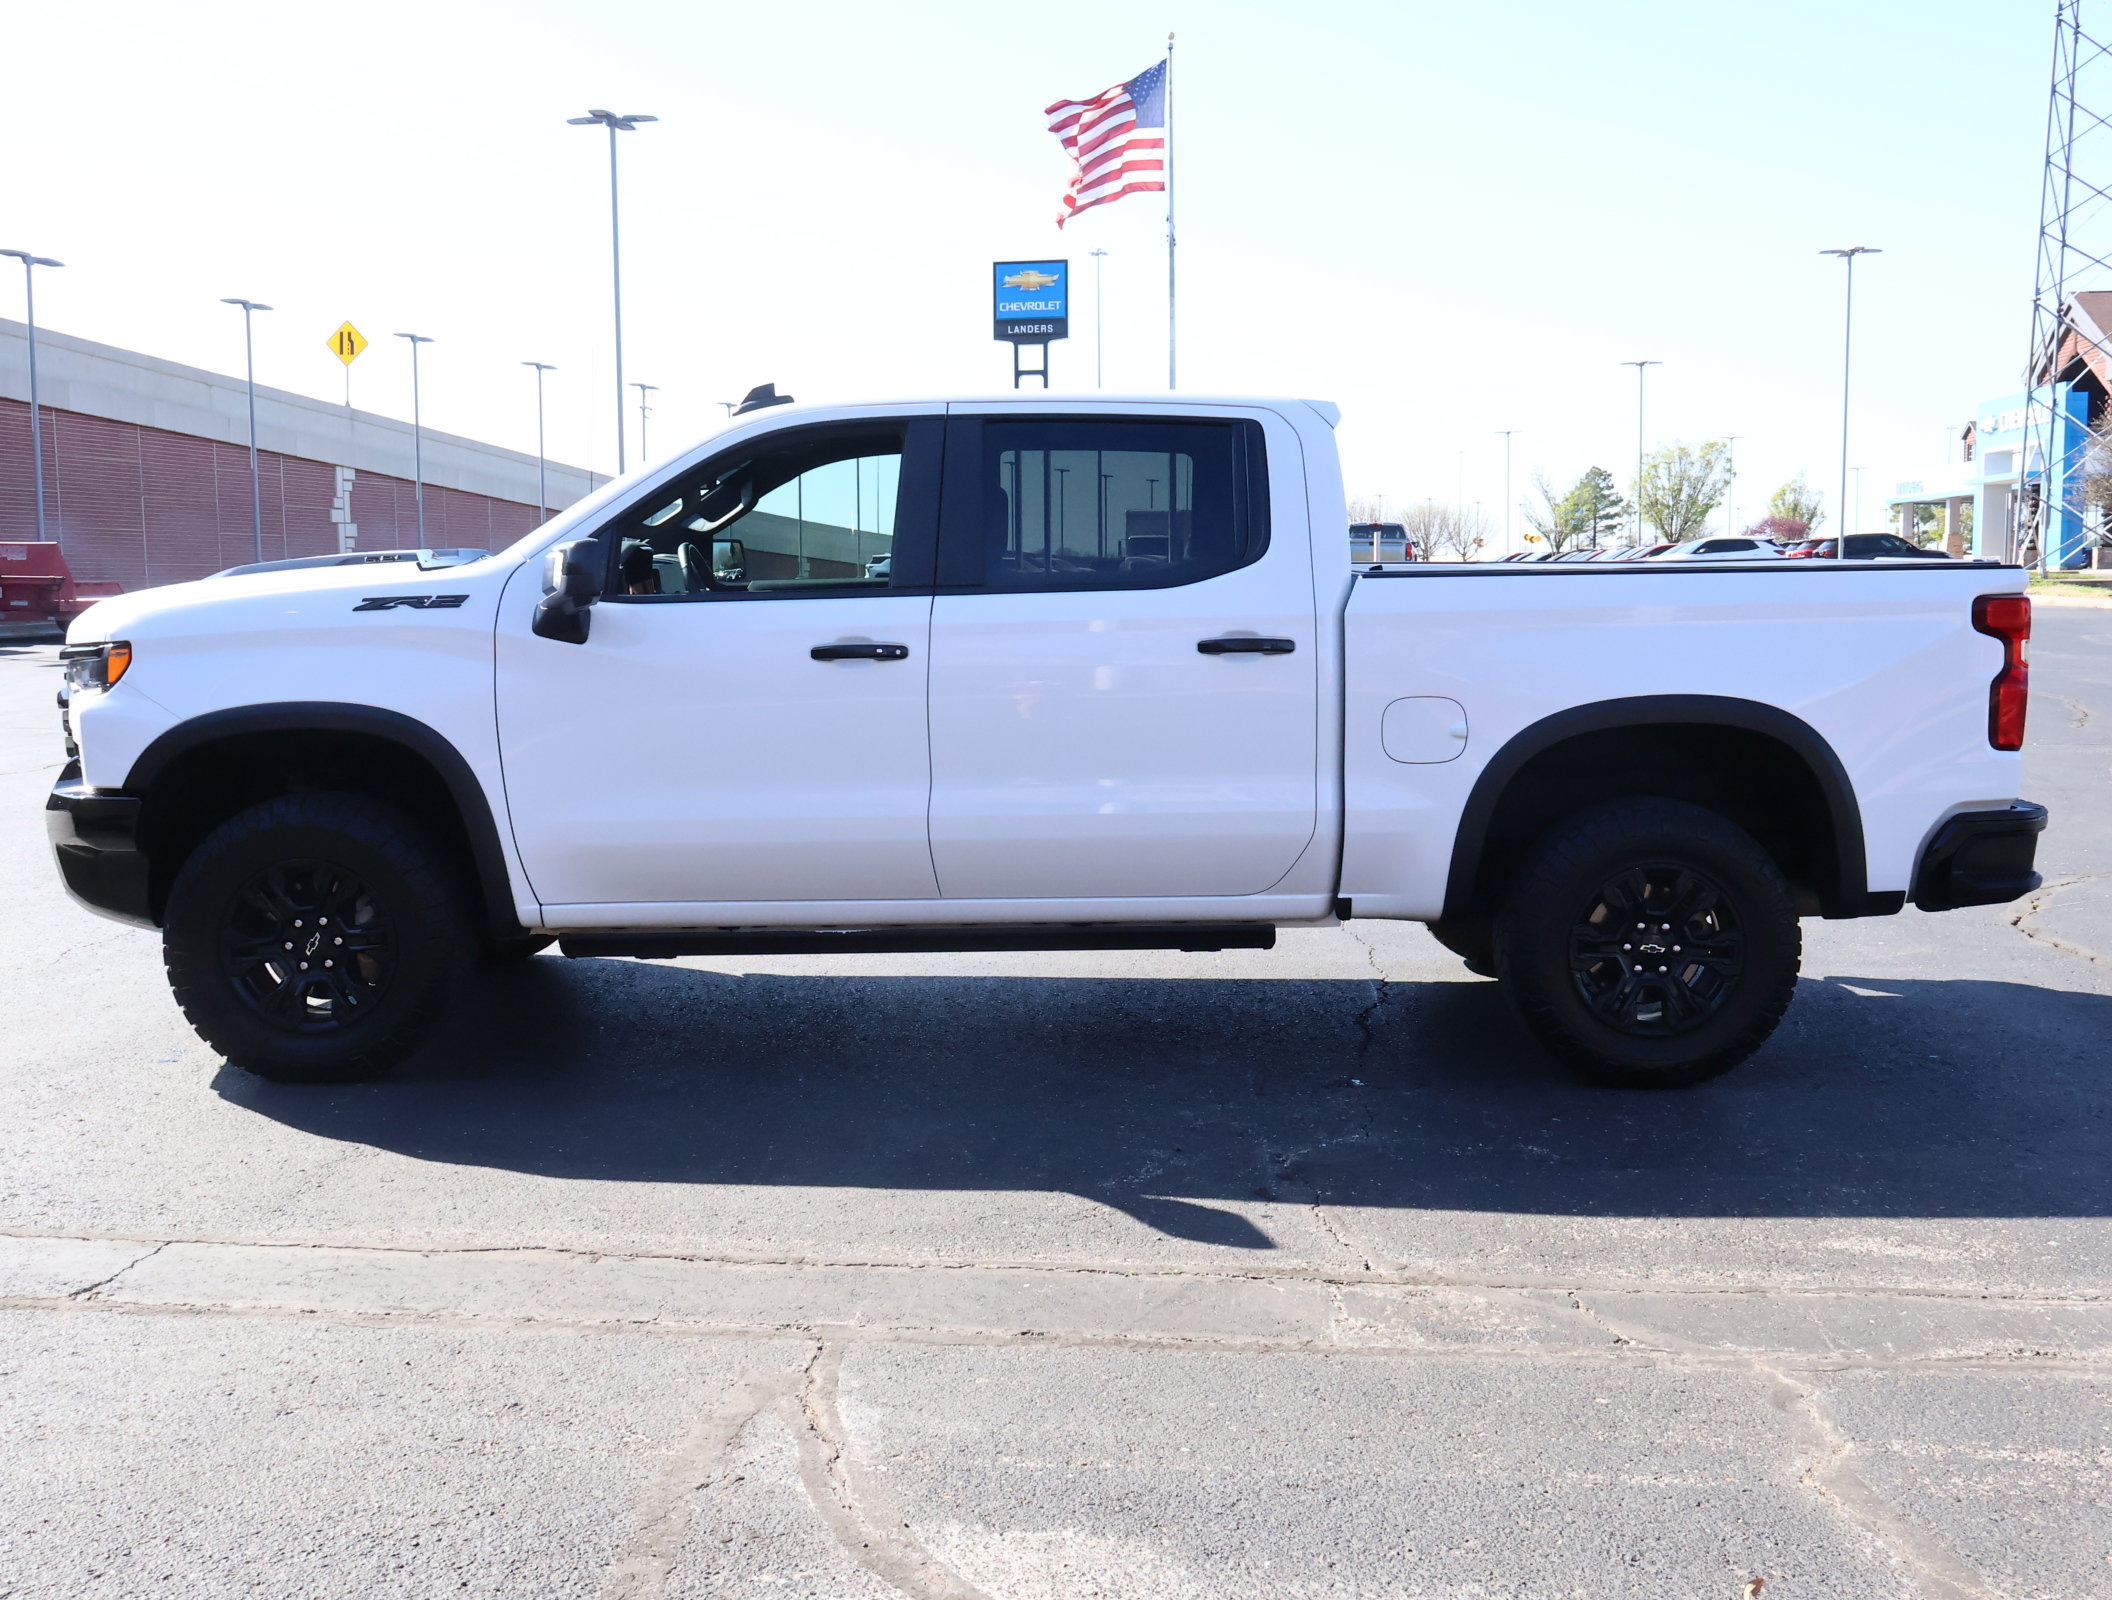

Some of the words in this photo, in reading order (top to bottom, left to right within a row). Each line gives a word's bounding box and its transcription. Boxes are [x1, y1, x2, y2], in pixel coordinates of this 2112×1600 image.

[999, 300, 1061, 312] CHEVROLET
[1007, 324, 1054, 334] LANDERS
[352, 594, 470, 612] ZR2
